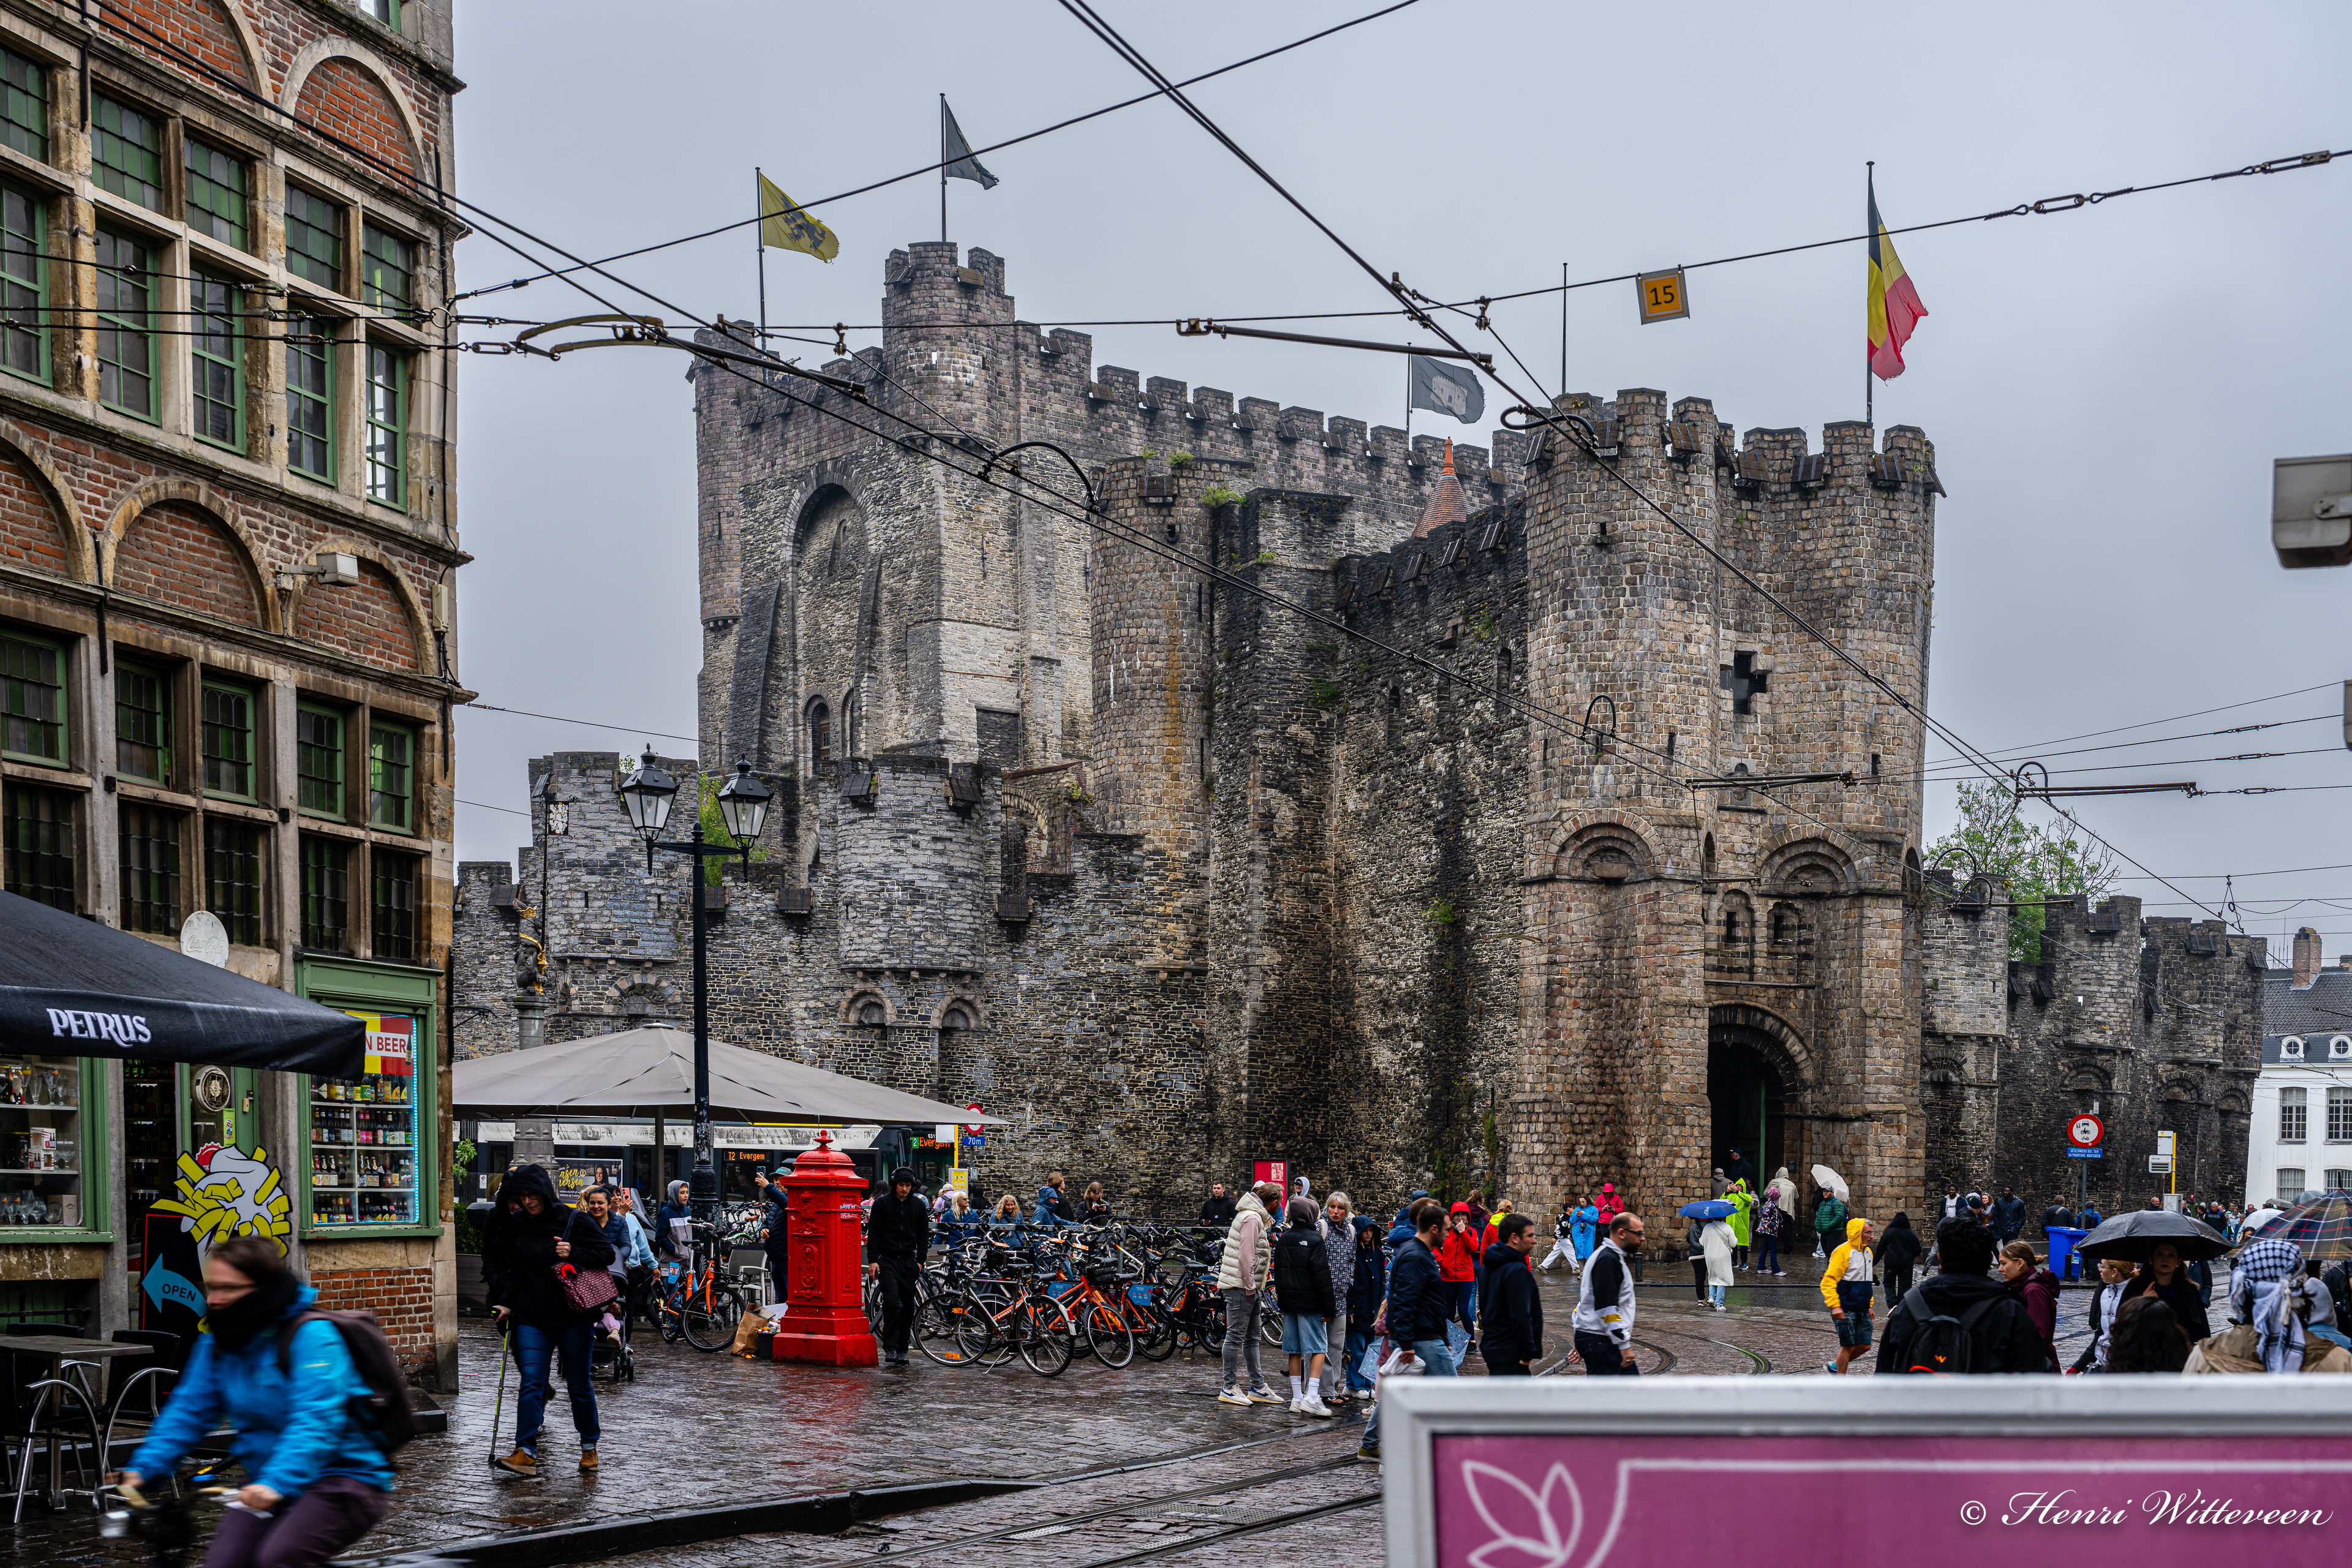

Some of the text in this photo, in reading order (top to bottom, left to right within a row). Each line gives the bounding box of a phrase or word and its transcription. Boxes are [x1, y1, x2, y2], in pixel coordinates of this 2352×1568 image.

[1650, 285, 1675, 306] 15
[46, 1008, 152, 1048] PETRUS
[377, 1036, 407, 1054] BEER
[728, 1152, 765, 1161] T2 Evergem
[162, 1283, 197, 1302] OPEN
[997, 1308, 1012, 1319] DONKEY
